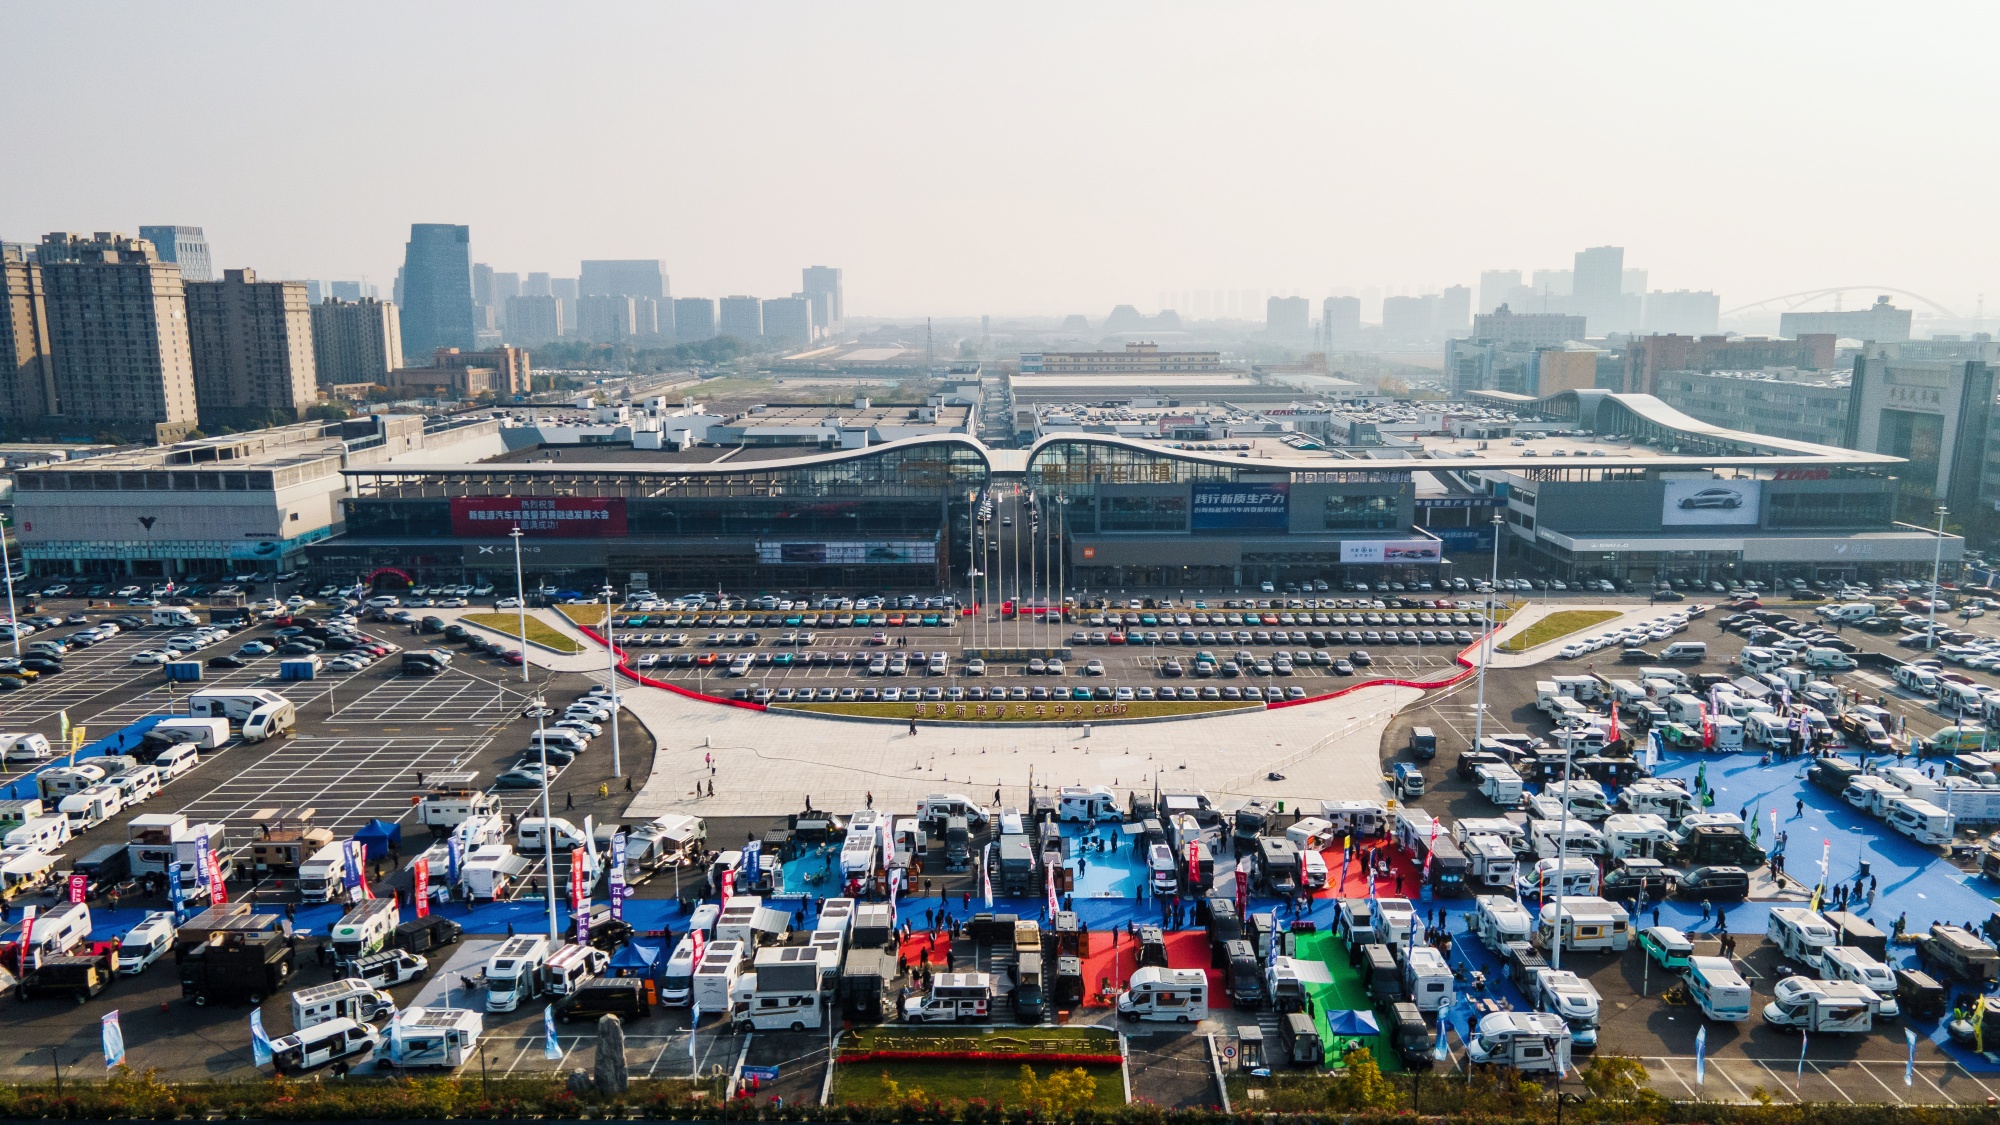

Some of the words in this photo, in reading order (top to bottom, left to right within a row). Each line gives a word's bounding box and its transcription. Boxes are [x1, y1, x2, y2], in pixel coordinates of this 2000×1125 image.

[1194, 493, 1285, 504] 践行新质生产力
[521, 500, 556, 509] 热烈祝贺
[469, 510, 610, 520] 新能源汽车高质量消费融通发展大会
[915, 703, 1085, 716] 超级新能源汽车中心
